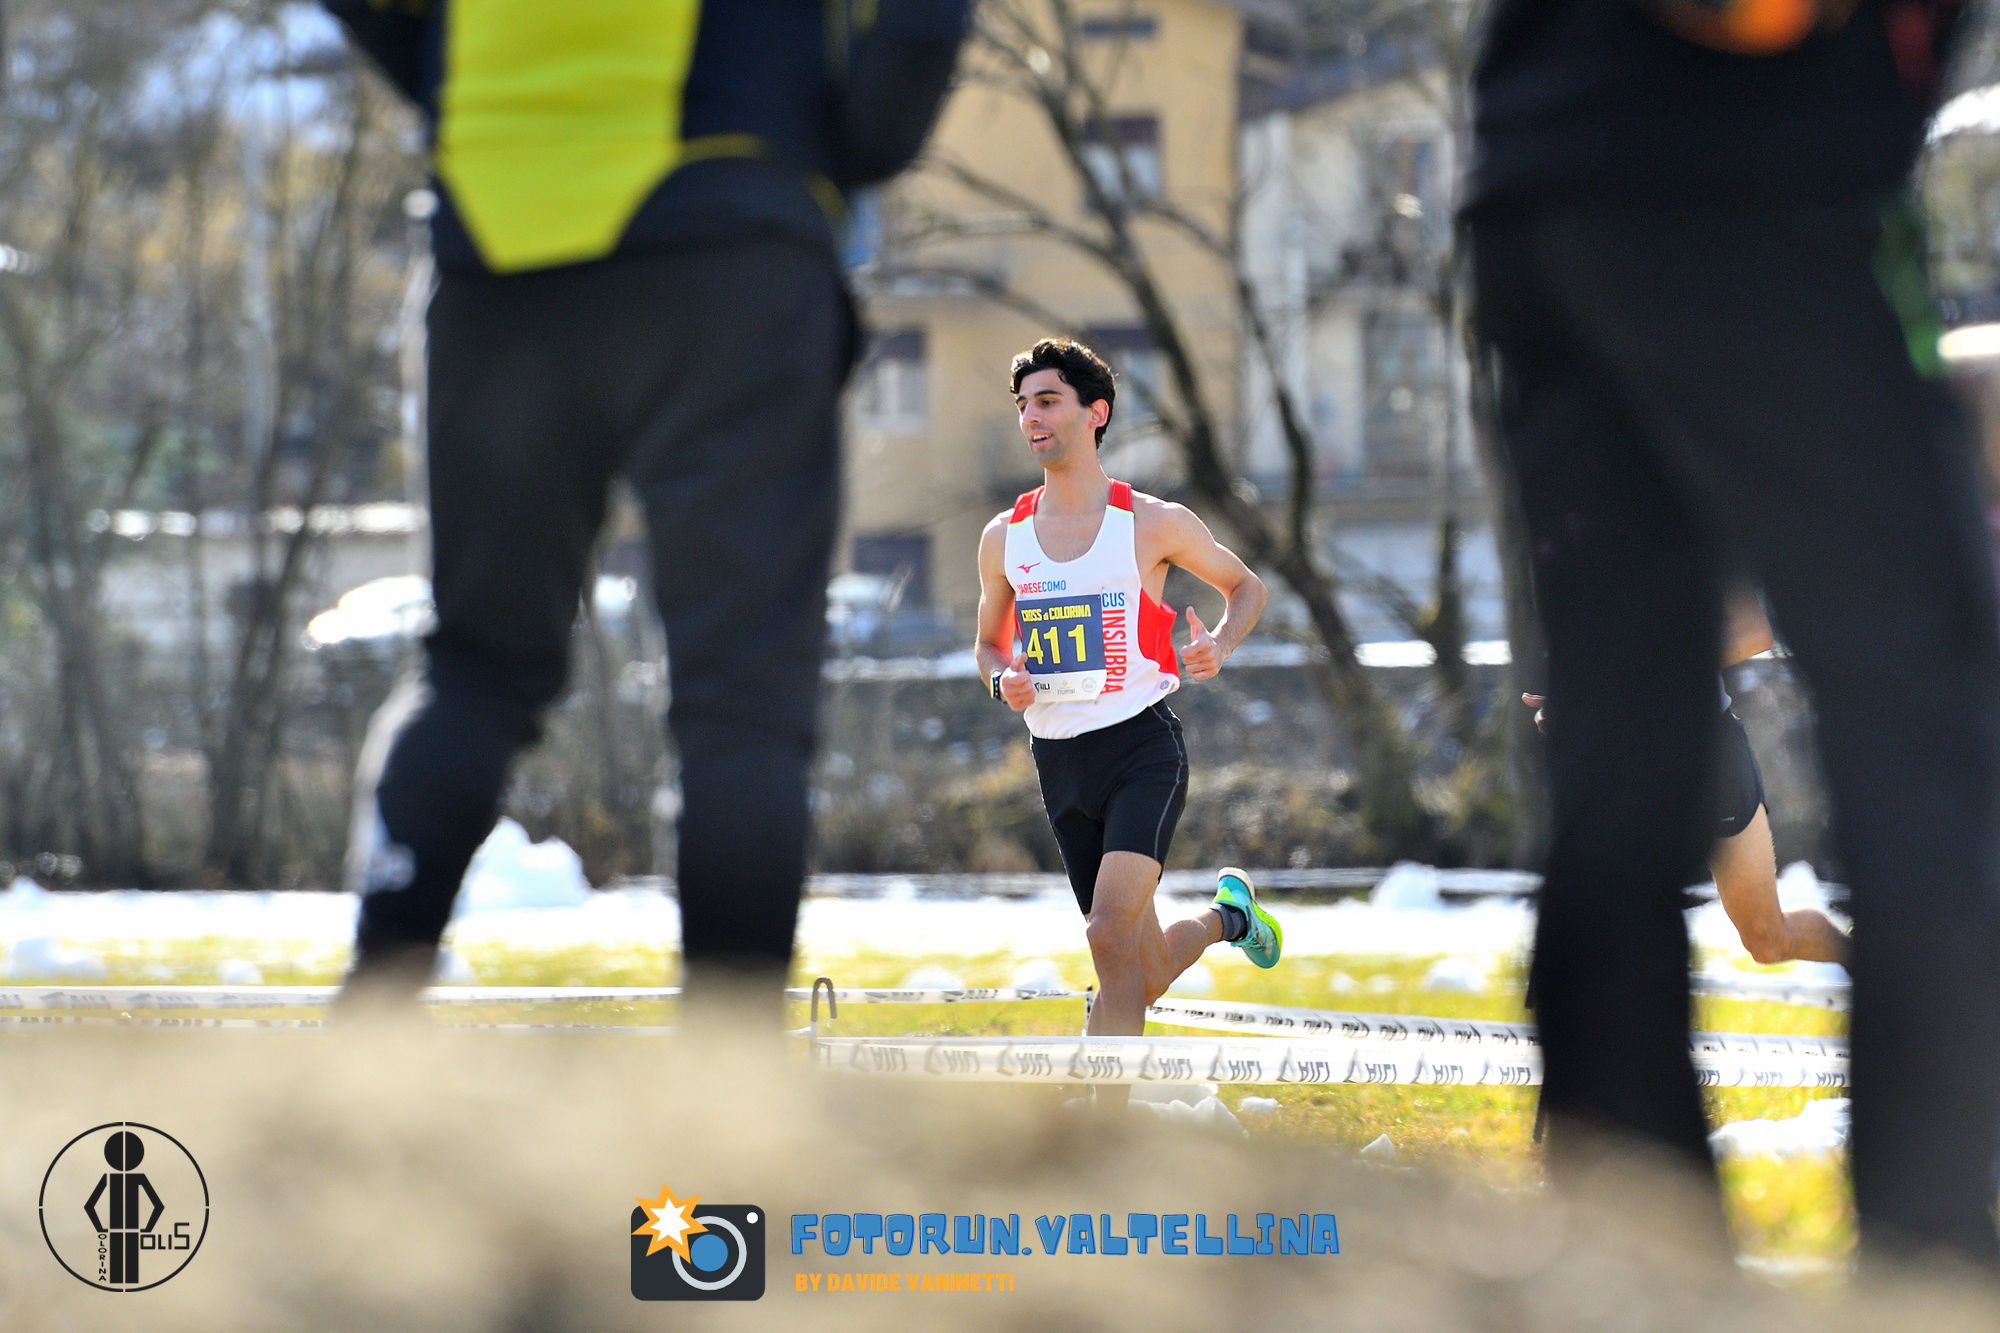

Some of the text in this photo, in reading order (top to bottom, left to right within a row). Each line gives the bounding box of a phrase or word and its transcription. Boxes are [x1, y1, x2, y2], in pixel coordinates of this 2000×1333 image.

[1021, 608, 1043, 622] CROSS
[1049, 604, 1092, 620] COLORINA
[1101, 592, 1125, 608] CUS
[1027, 624, 1087, 665] 411
[1100, 609, 1128, 695] INSUBRIA
